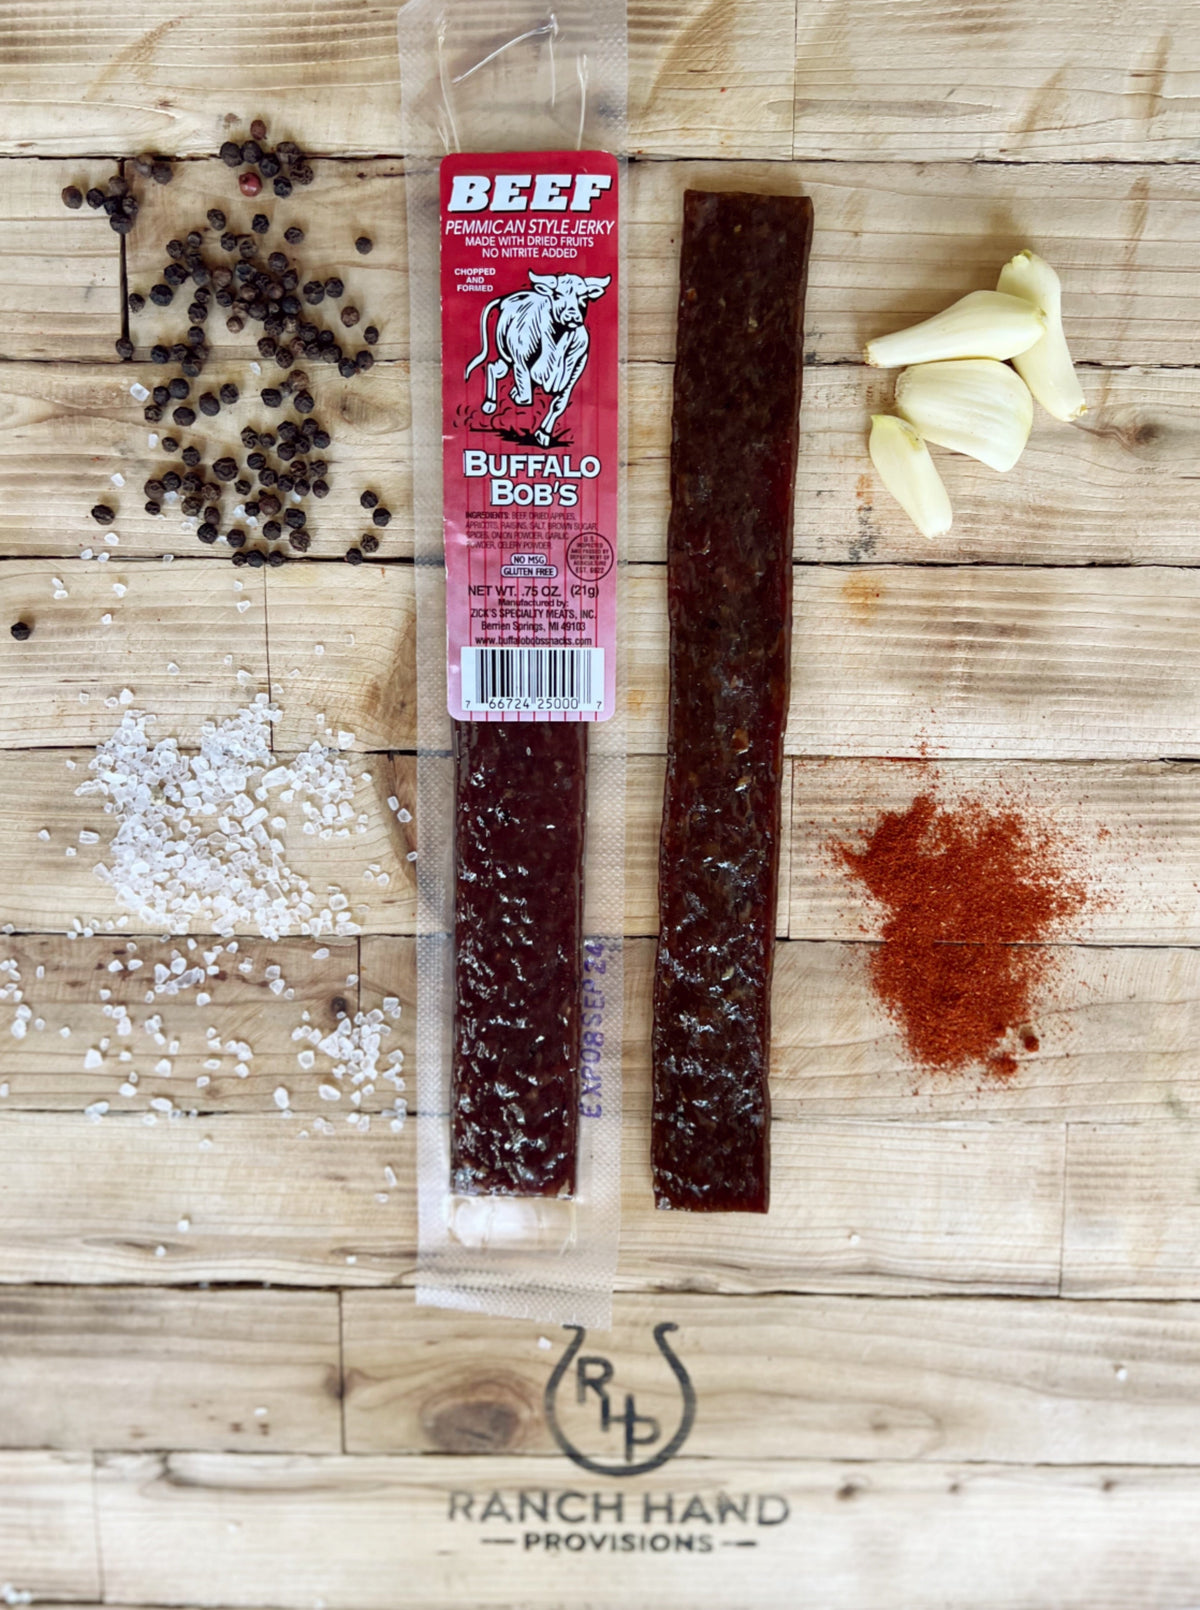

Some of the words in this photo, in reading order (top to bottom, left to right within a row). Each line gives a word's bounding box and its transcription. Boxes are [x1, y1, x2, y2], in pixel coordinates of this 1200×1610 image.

[447, 174, 613, 213] BEEF
[445, 219, 526, 235] PEMMICAN
[528, 219, 570, 234] STYLE
[571, 220, 615, 235] JERKY
[465, 236, 496, 247] MADE
[498, 236, 525, 246] WITH
[527, 236, 558, 247] DRIED
[560, 237, 594, 247] FRUITS
[482, 248, 499, 258] NO
[501, 248, 539, 258] NITRITE
[541, 248, 578, 258] ADDED
[454, 268, 496, 276] CHOPPED
[466, 276, 485, 284] AND
[456, 284, 494, 292] FORMED
[463, 449, 601, 478] BUFFALO
[490, 478, 578, 507] BOB'S
[513, 555, 526, 564] NO
[527, 555, 545, 565] MSG
[503, 567, 534, 576] GLUTEN
[535, 567, 555, 576] FREE
[468, 585, 493, 596] NET
[495, 585, 518, 597] WT.
[521, 585, 539, 597] .75
[541, 586, 562, 597] OZ.
[570, 584, 600, 598] (21g)
[498, 599, 555, 607] Manufactured
[556, 599, 569, 608] by:
[470, 608, 498, 618] ZICK'S
[499, 608, 544, 619] SPECIALTY
[546, 609, 578, 620] MEATS,
[580, 610, 597, 619] INC.
[481, 621, 510, 631] Berrien
[512, 621, 546, 633] Springs,
[548, 622, 559, 631] MI
[561, 622, 586, 631] 49103
[475, 635, 592, 646] www.buffalobobssnacks.com
[489, 698, 530, 709] 66724
[537, 698, 579, 709] 25000
[596, 701, 602, 709] 7
[449, 1491, 625, 1523] RANCH
[643, 1491, 791, 1526] HAND
[523, 1533, 714, 1552] PROVISIONS
